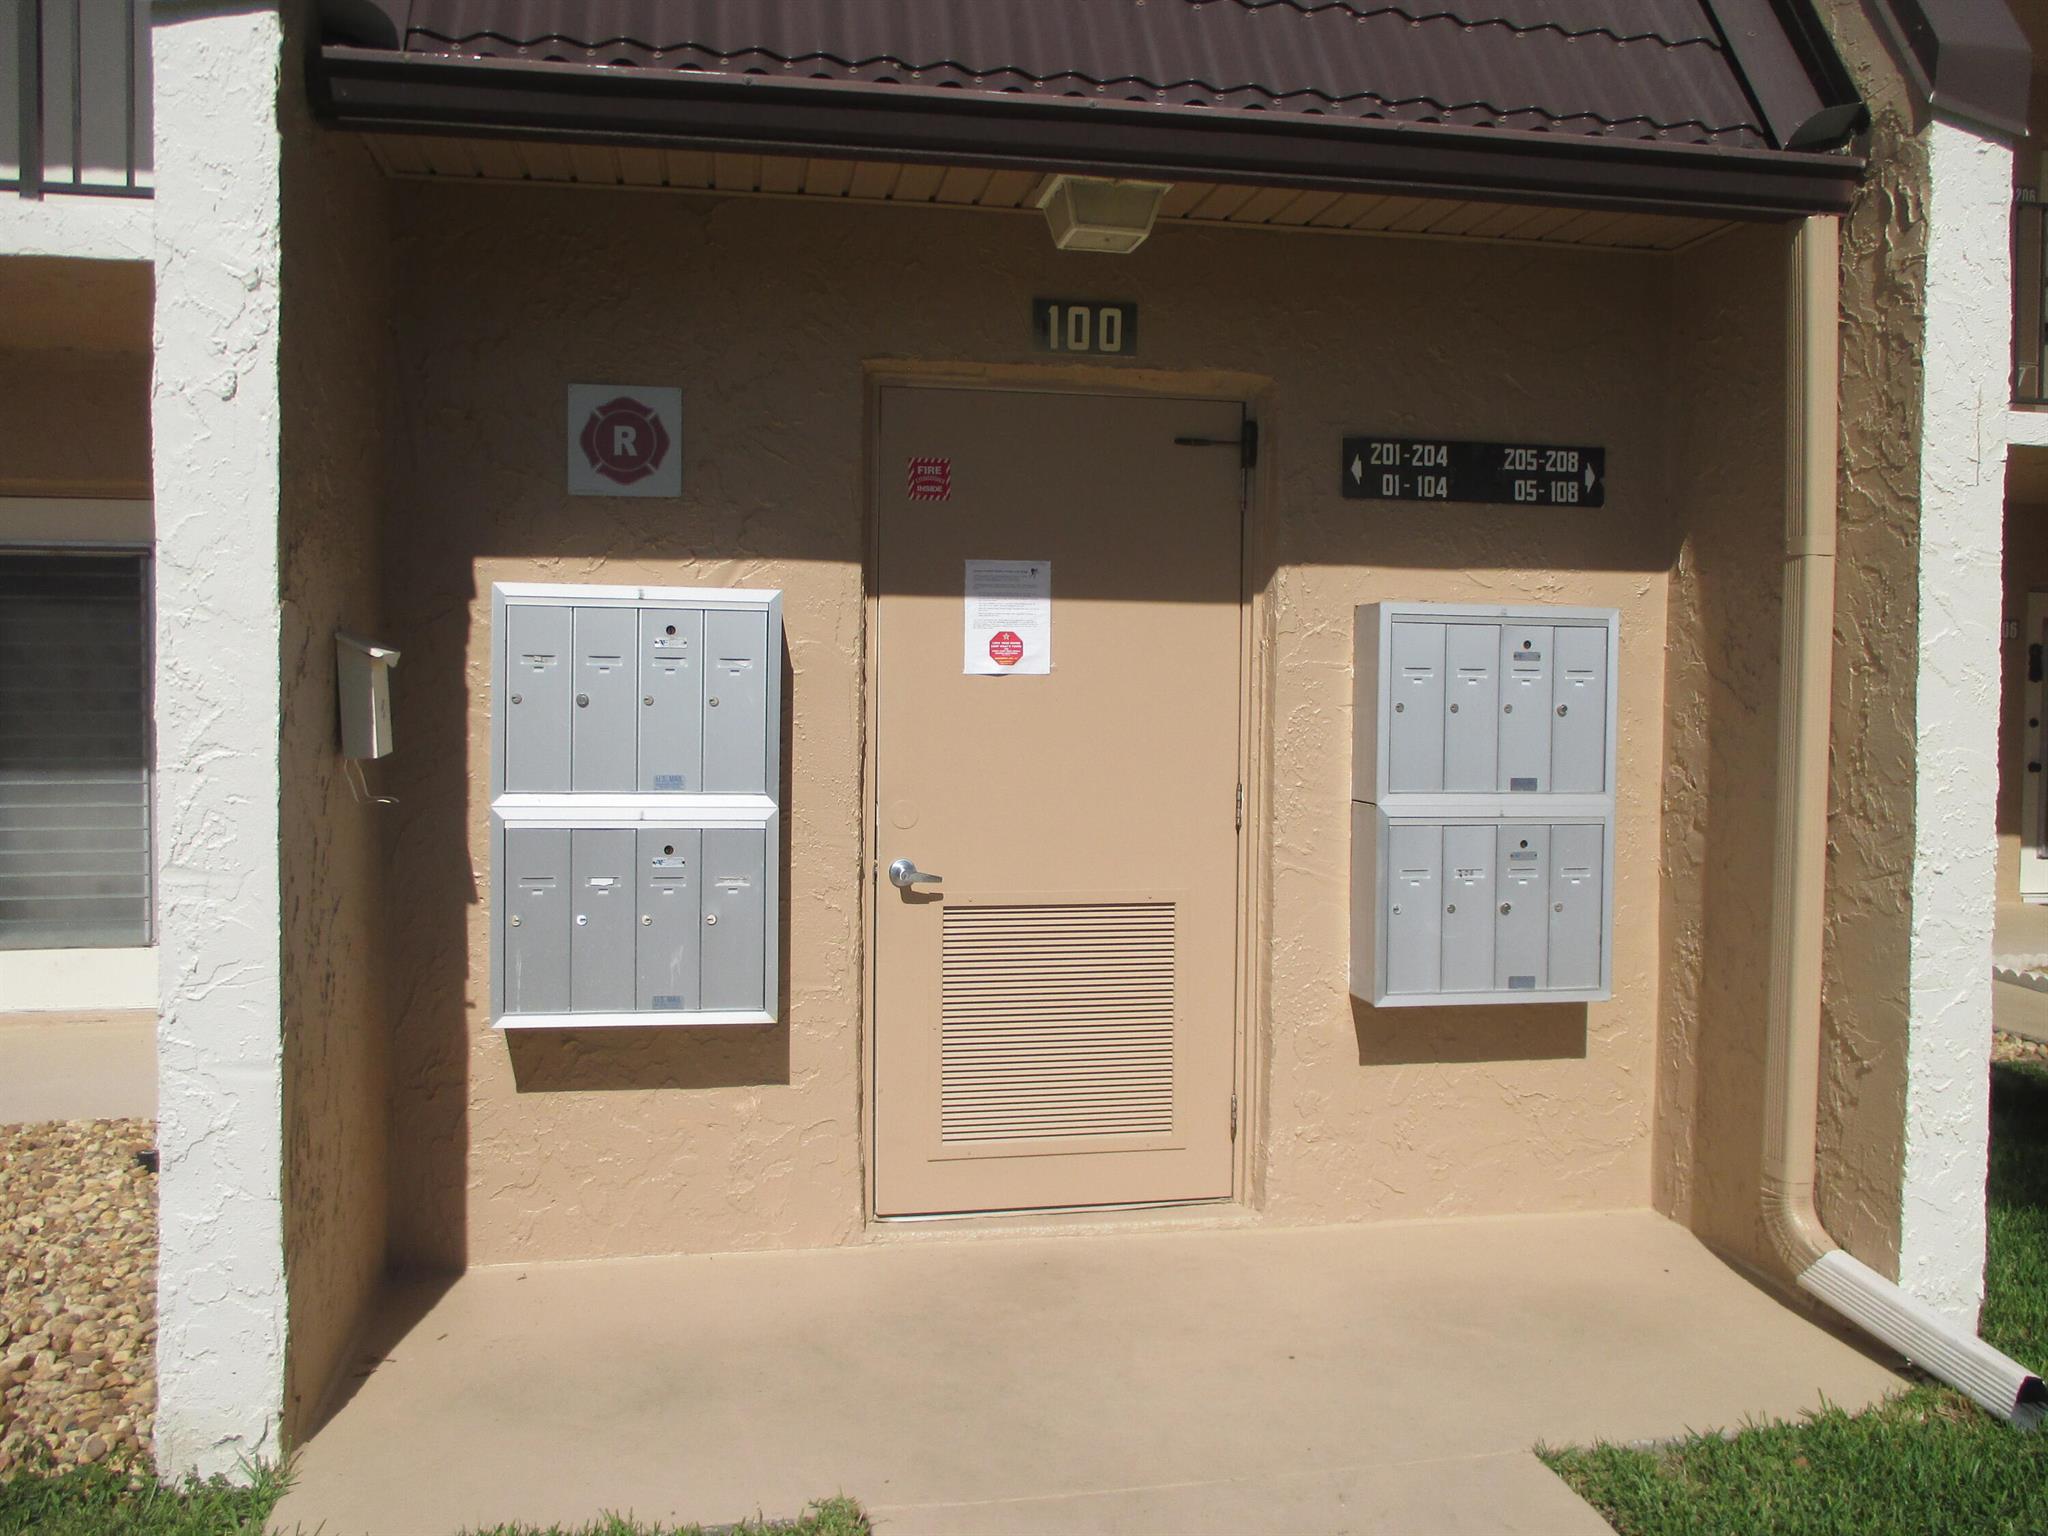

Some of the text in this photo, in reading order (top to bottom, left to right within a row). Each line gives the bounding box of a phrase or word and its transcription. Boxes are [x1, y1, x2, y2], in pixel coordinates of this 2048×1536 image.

[1048, 305, 1122, 352] 100
[614, 425, 637, 456] R
[1370, 443, 1448, 467] 201-204
[1504, 448, 1579, 473] 205-208
[917, 466, 942, 474] FIRE
